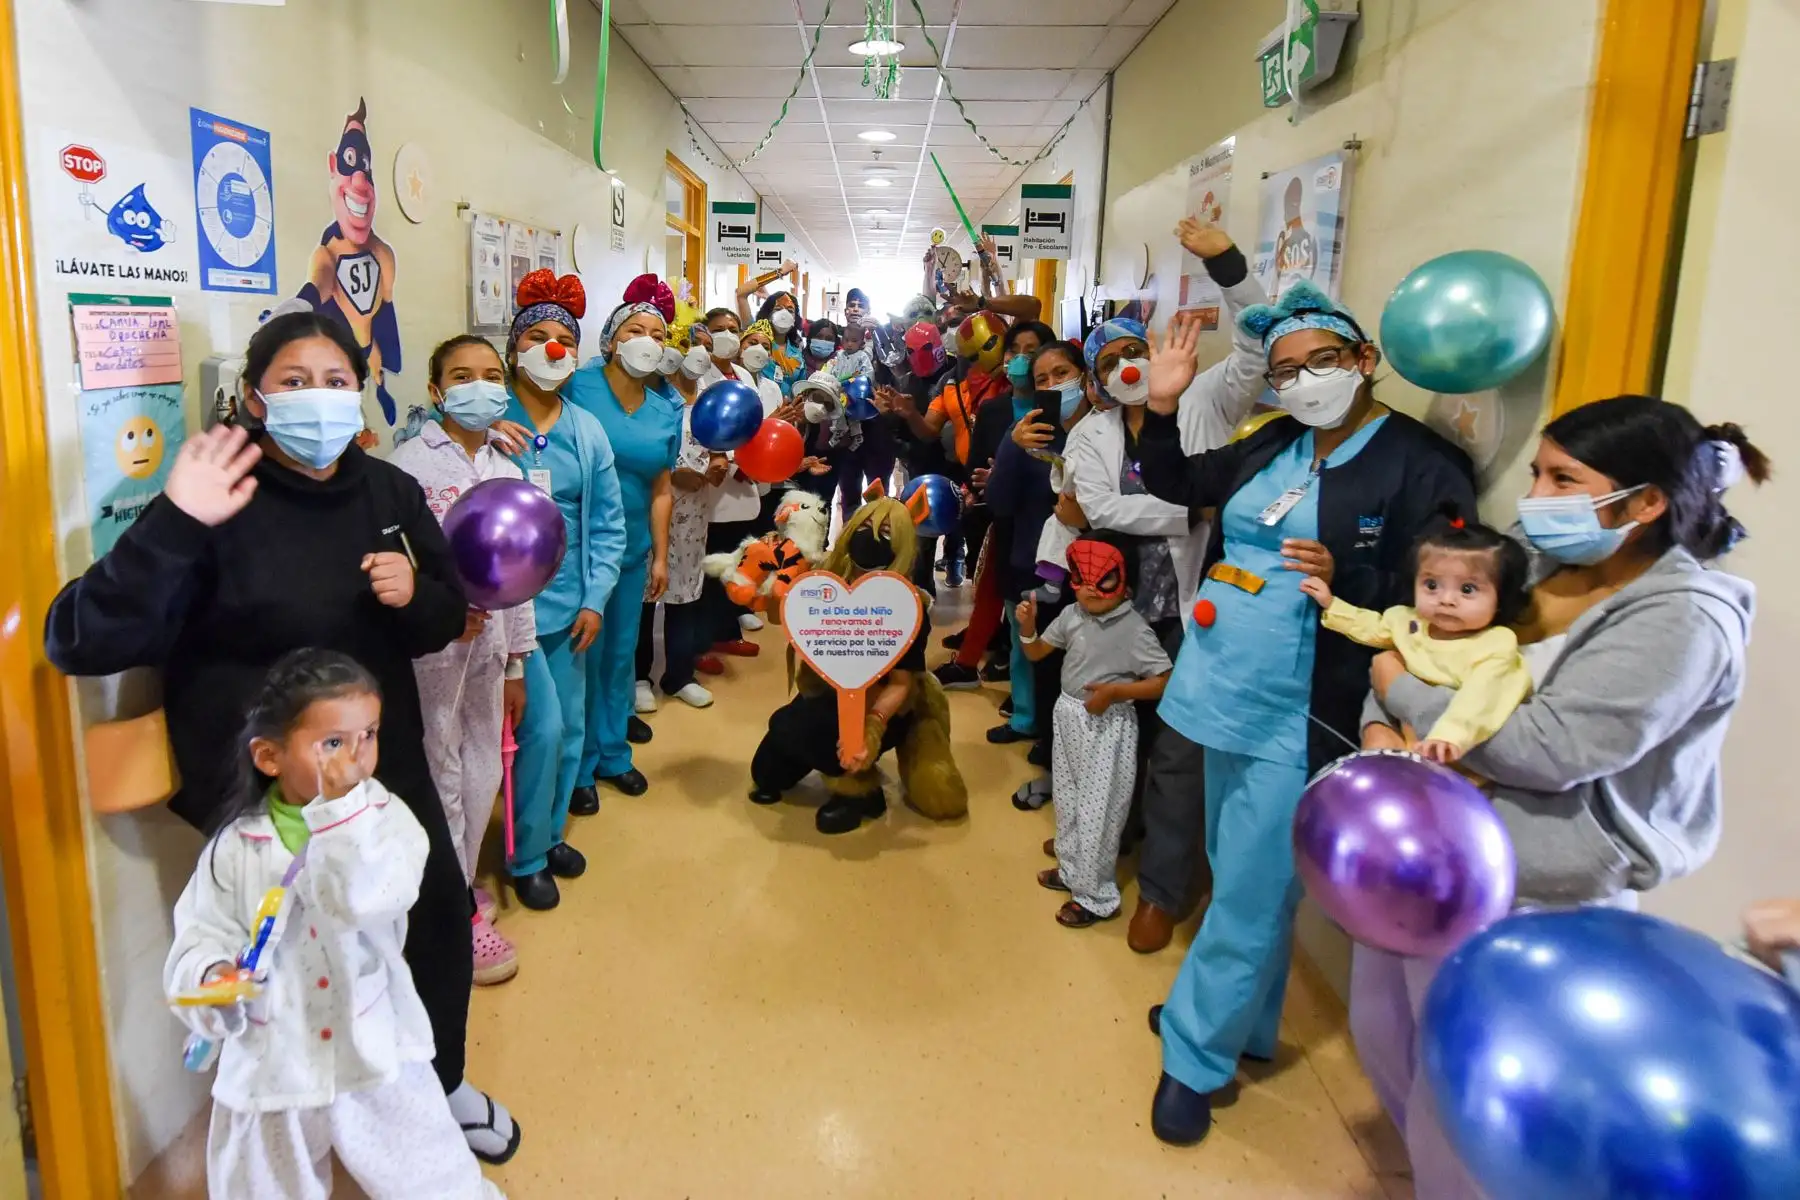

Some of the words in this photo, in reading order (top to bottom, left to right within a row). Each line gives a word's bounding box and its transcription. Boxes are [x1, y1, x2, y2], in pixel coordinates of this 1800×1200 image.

[64, 154, 102, 173] STOP
[614, 184, 624, 225] S
[56, 257, 115, 277] ¡LÁVATE
[118, 265, 141, 279] LAS
[144, 267, 188, 283] MANOS!
[350, 261, 371, 295] SJ
[809, 606, 820, 615] En
[822, 606, 832, 615] el
[852, 606, 868, 615] del
[871, 606, 893, 615] Niño
[821, 618, 872, 626] renovamos
[875, 617, 883, 626] el
[799, 628, 852, 637] compromiso
[854, 627, 865, 636] de
[867, 628, 903, 638] entrega
[806, 639, 811, 647] y
[814, 638, 847, 646] servicio
[849, 639, 864, 647] por
[866, 638, 875, 646] la
[877, 638, 896, 646] vida
[813, 648, 824, 656] de
[826, 648, 864, 656] nuestros
[866, 648, 889, 656] niños
